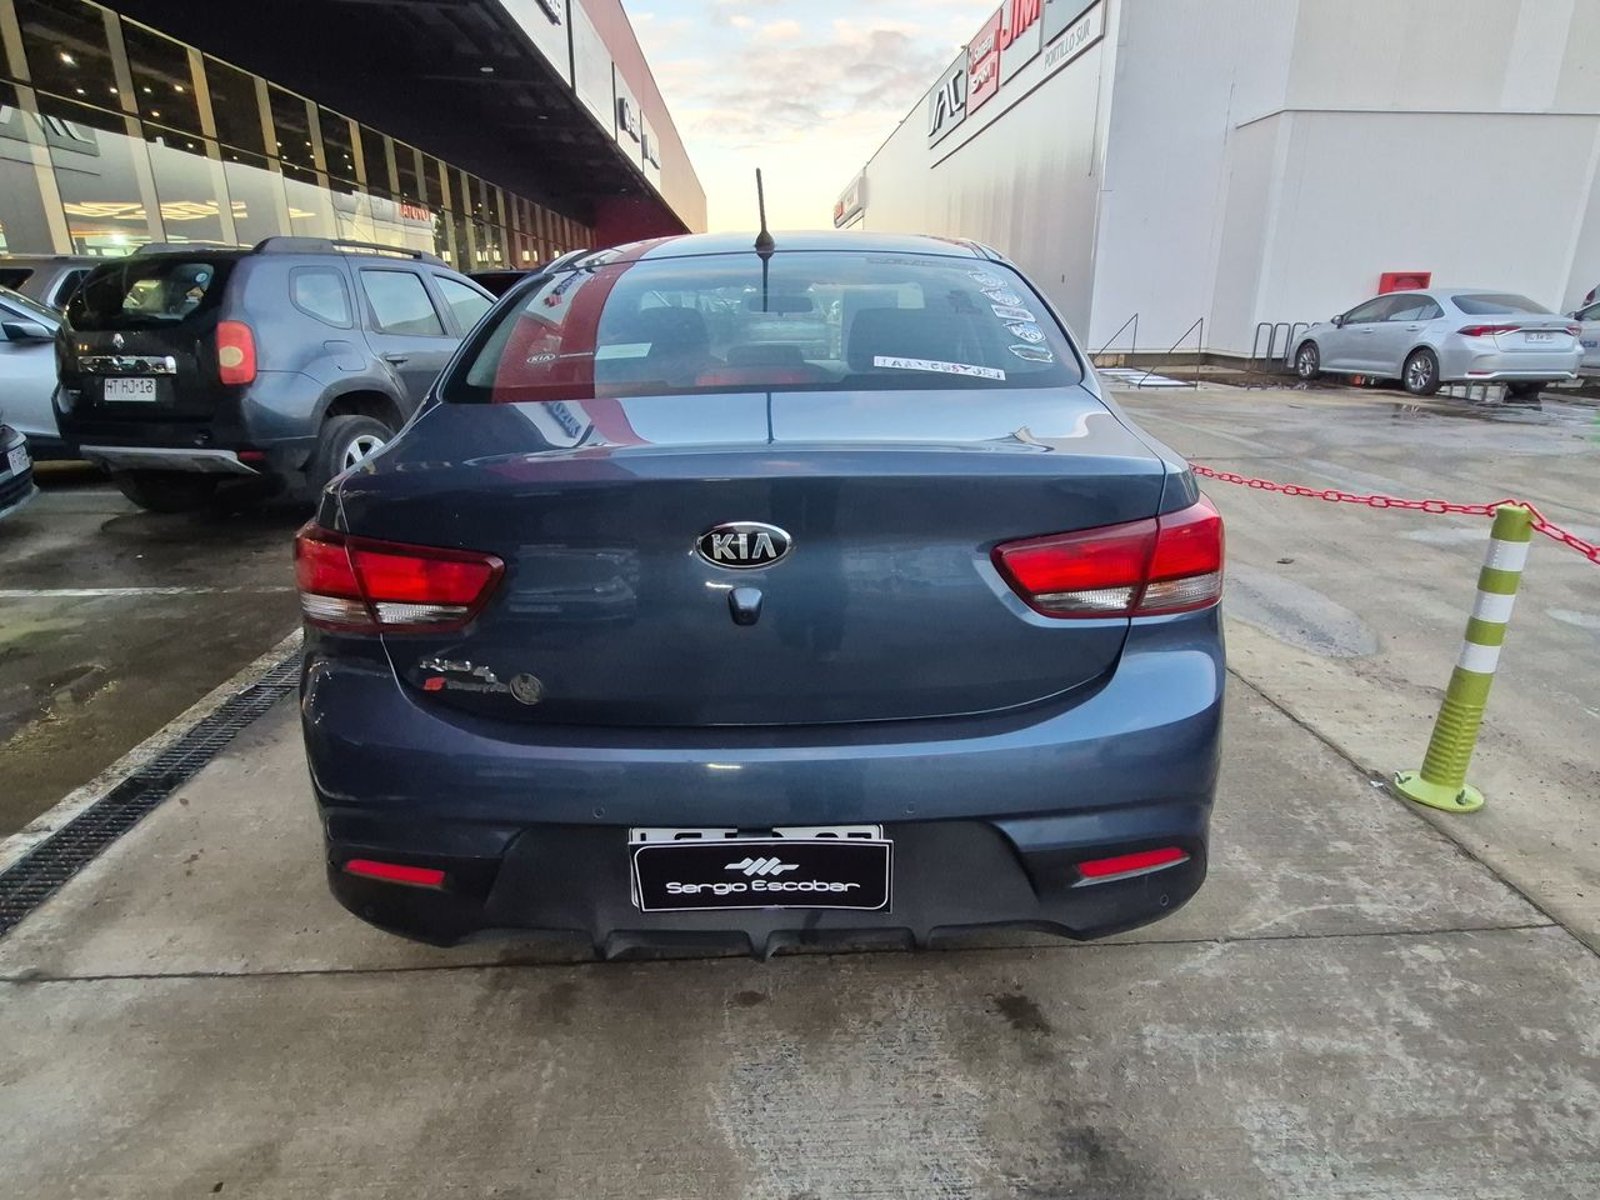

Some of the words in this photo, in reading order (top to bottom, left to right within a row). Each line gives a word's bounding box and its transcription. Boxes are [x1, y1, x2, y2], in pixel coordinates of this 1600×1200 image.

[711, 532, 777, 560] KIA
[665, 881, 748, 896] Sergio
[751, 879, 861, 893] Escobar
